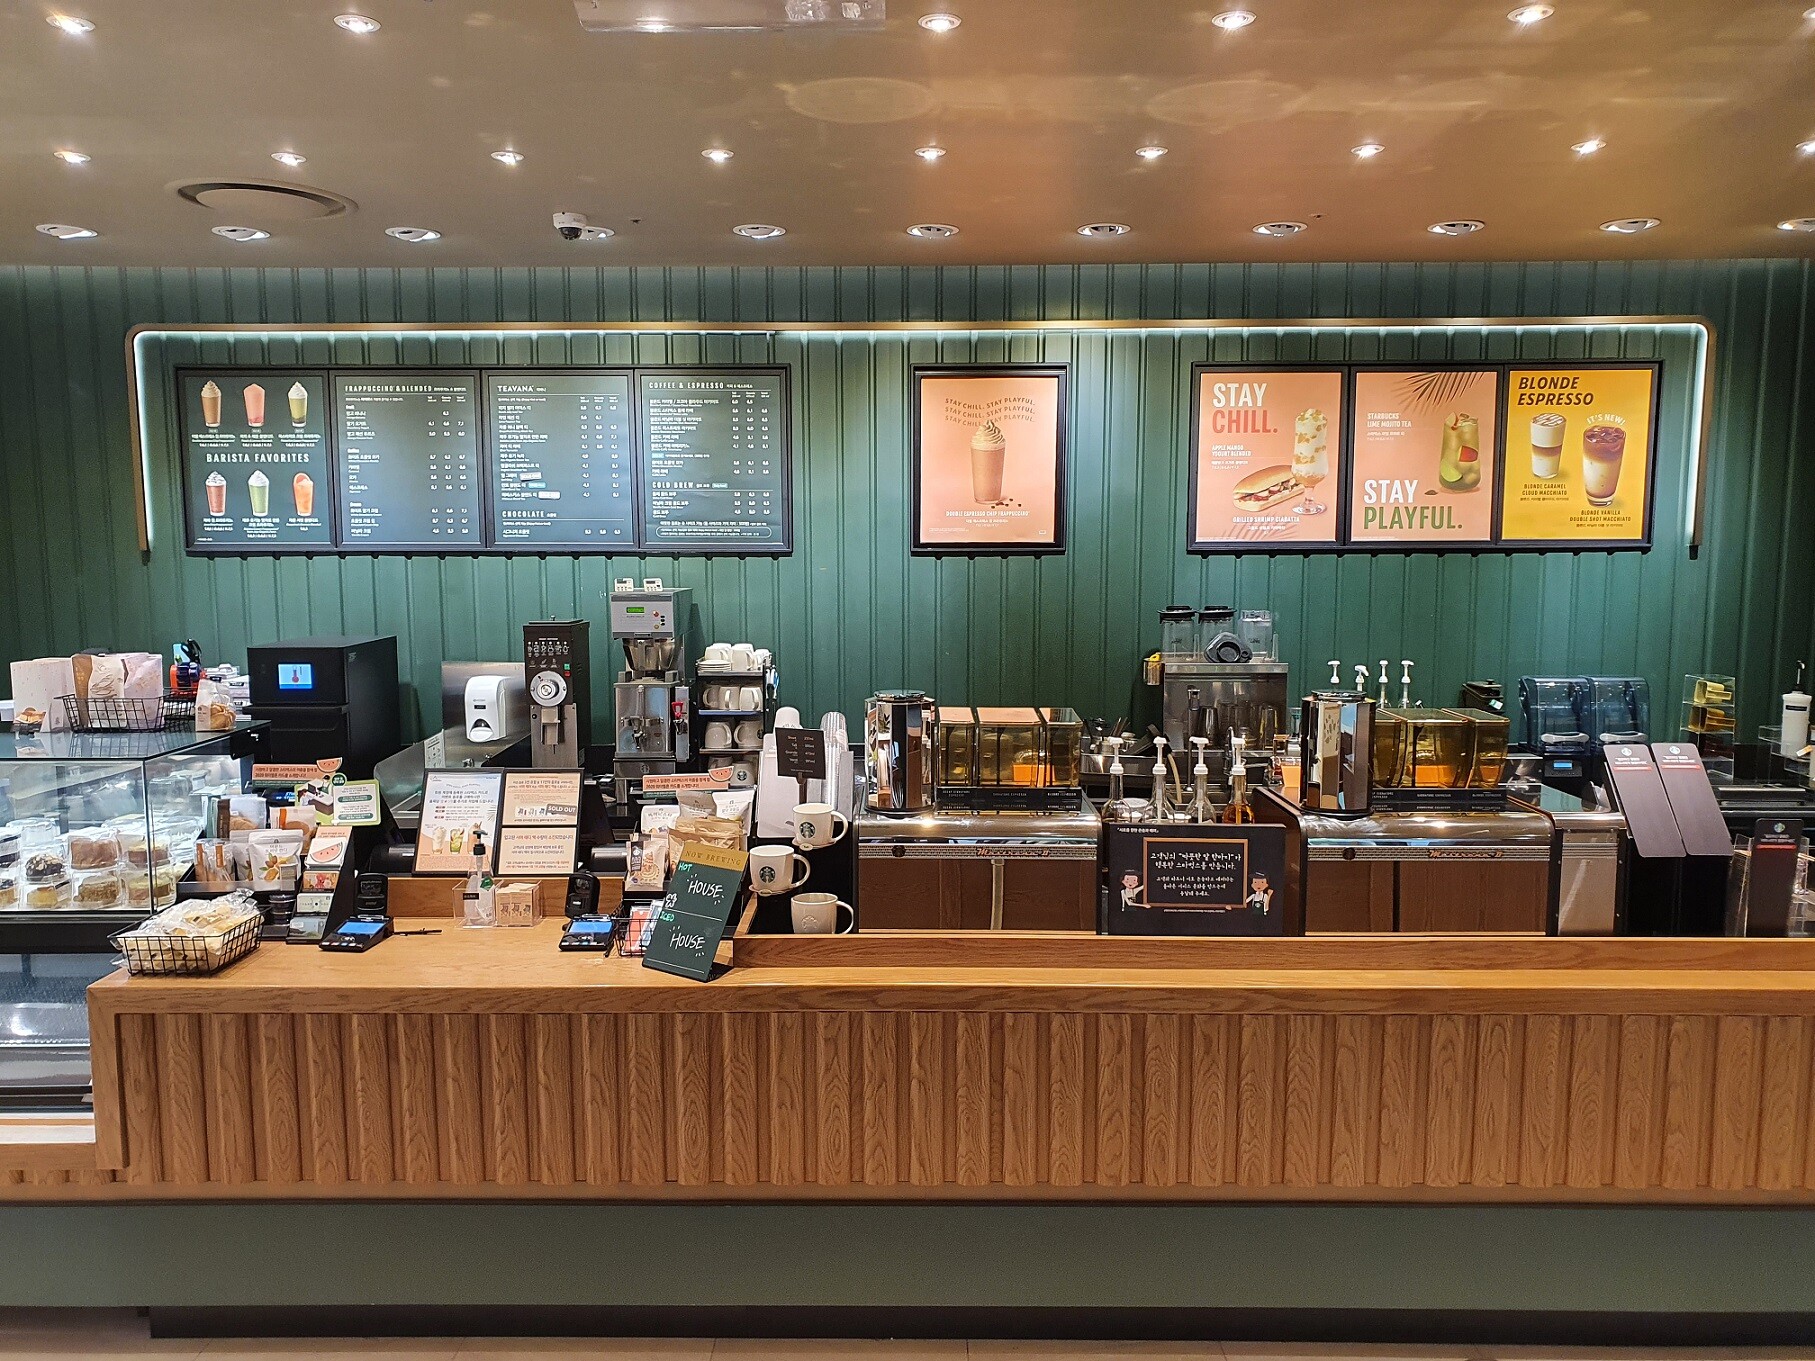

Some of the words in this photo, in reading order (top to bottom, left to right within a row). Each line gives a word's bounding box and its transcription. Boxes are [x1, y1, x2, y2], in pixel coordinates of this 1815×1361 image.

[1518, 376, 1580, 390] BLONDE
[1212, 382, 1267, 408] STAY
[1517, 392, 1594, 406] ESPRESSO
[945, 398, 962, 407] STAY
[986, 399, 1002, 409] STAY
[1004, 397, 1035, 406] PLAYFUL.
[945, 406, 961, 415] STAY
[986, 407, 1002, 417] STAY
[1004, 405, 1035, 414] PLAYFUL.
[1367, 412, 1400, 420] STARBUCKS
[945, 415, 961, 424] STAY
[1212, 409, 1278, 434] CHILL.
[1604, 413, 1627, 426] NEW!
[206, 453, 250, 463] BARISTA
[254, 453, 310, 463] FAVORITES
[652, 481, 671, 489] COLD
[674, 481, 694, 489] BREW
[1363, 479, 1418, 504] STAY
[502, 510, 545, 518] CHOCOLATE
[1363, 506, 1463, 530] PLAYFUL.
[547, 804, 563, 812] SOLD
[685, 850, 704, 859] NOW
[705, 854, 742, 867] BREWING
[1150, 852, 1176, 860] 고객님의
[678, 862, 693, 872] HOT
[688, 880, 724, 898] HOUSE
[660, 911, 675, 922] ICED
[669, 932, 706, 950] HOUSE
